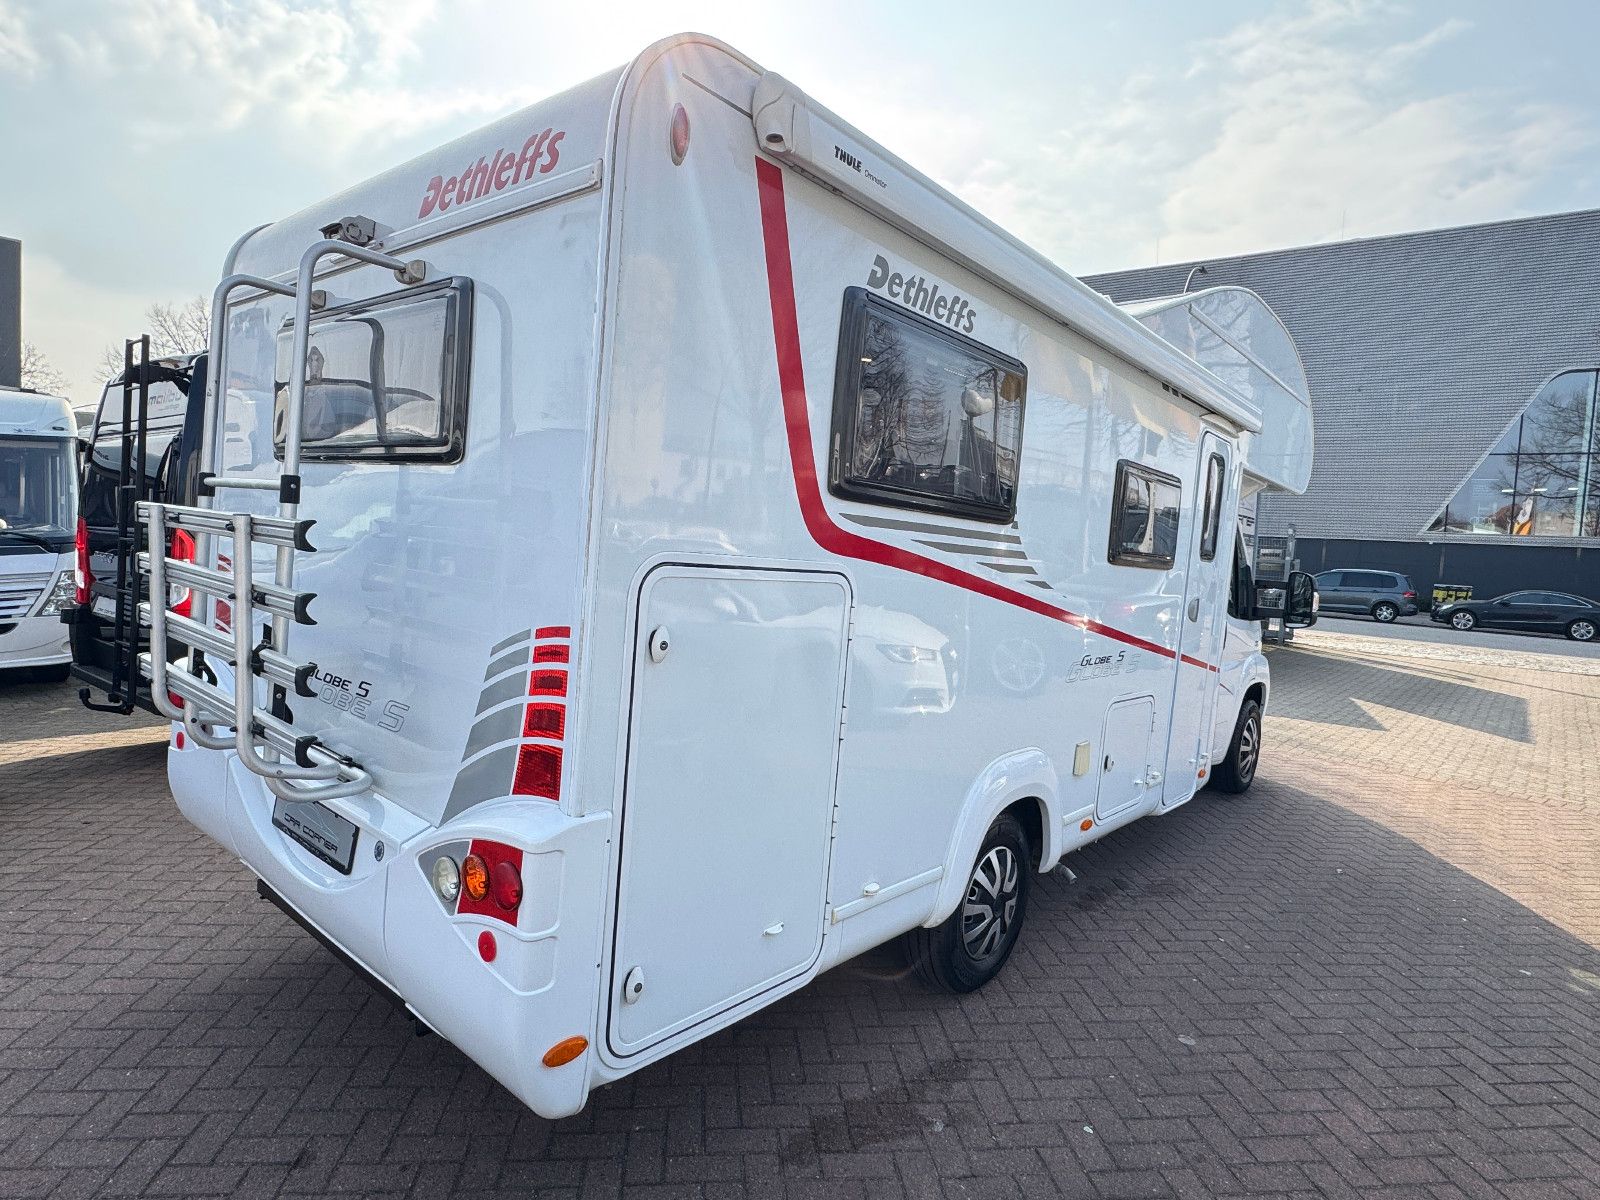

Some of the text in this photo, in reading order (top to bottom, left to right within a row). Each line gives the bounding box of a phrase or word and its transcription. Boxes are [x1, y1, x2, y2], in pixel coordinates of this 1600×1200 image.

[418, 127, 566, 219] Dethleffs
[834, 145, 862, 173] THULE
[866, 254, 977, 334] Dethleffs
[1080, 650, 1126, 667] GLOBE S
[355, 680, 373, 698] S
[377, 699, 411, 733] S
[284, 812, 301, 829] CAR
[302, 825, 339, 855] CORNER
